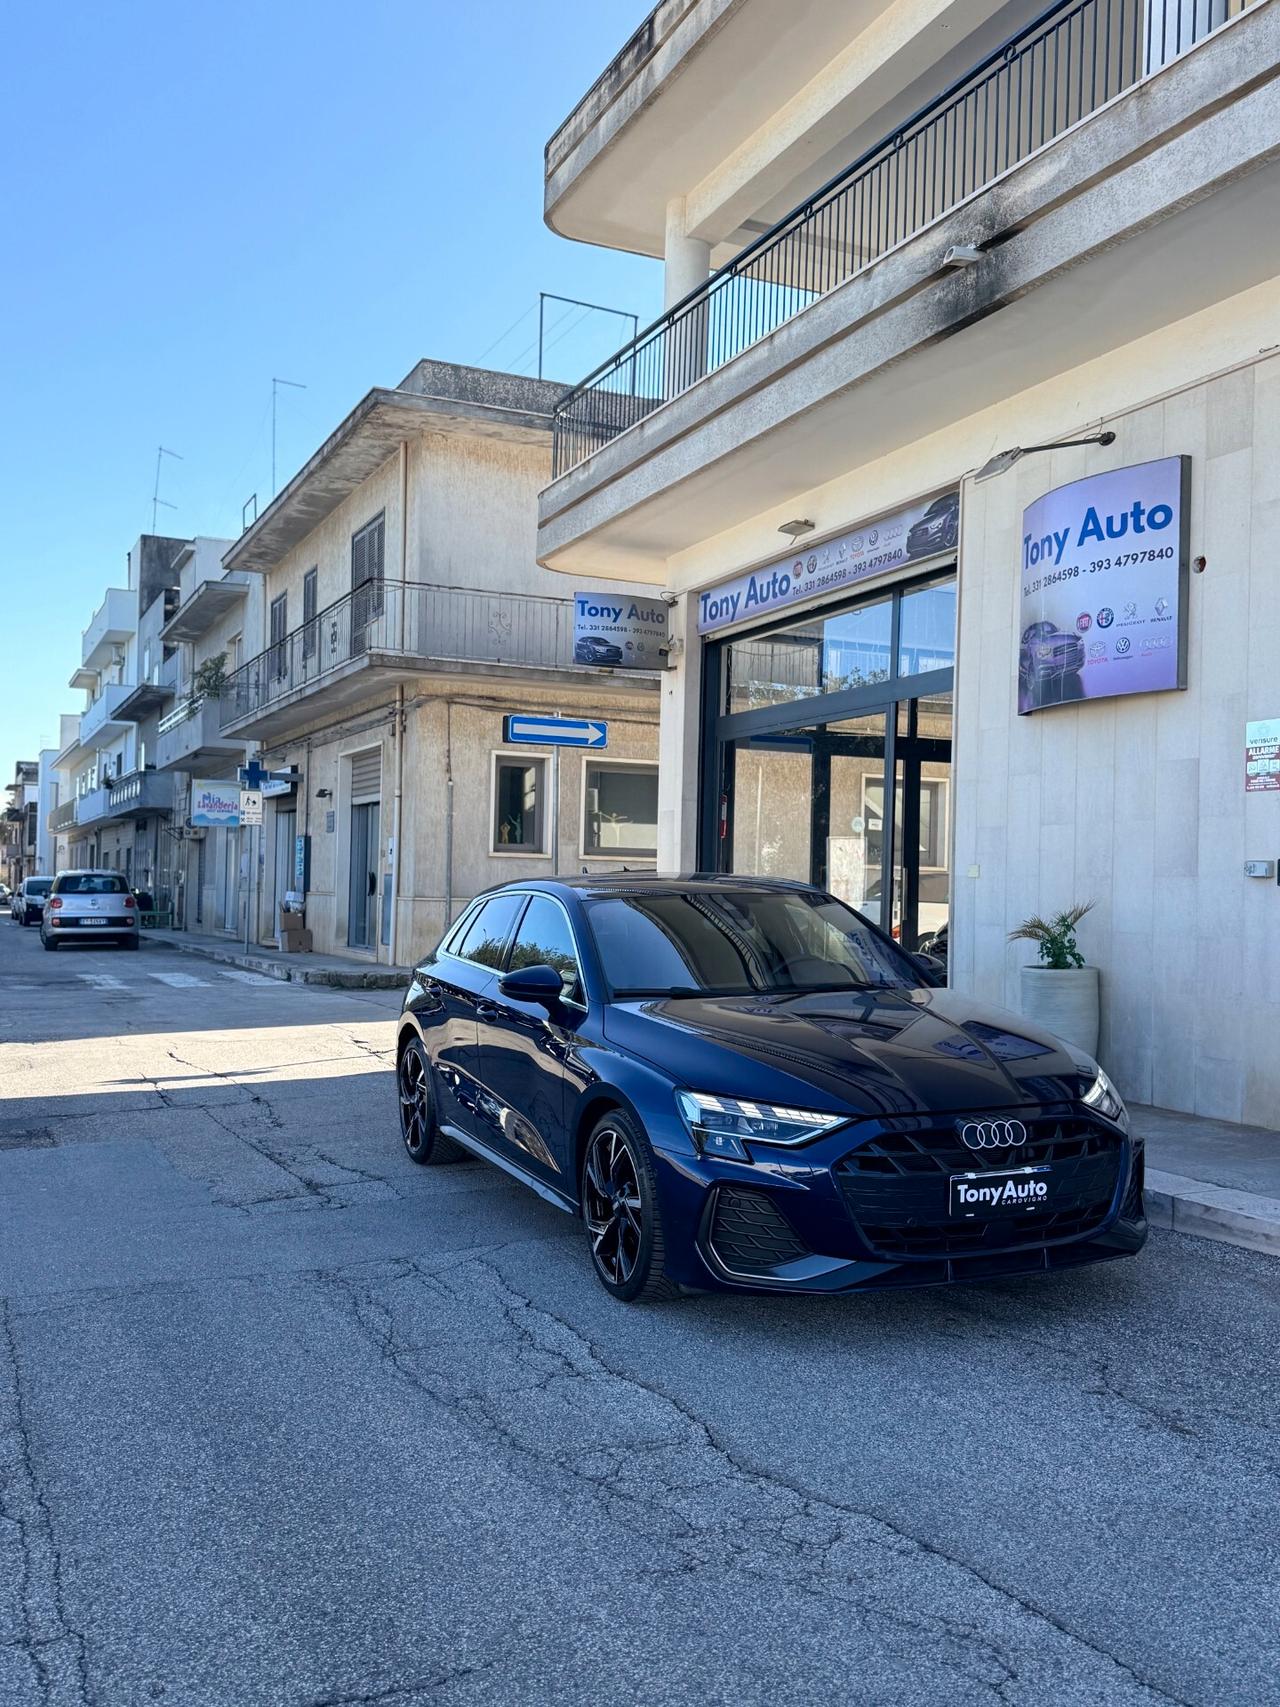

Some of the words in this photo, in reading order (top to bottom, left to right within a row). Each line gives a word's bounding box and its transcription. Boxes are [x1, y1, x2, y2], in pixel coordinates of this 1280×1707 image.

[1024, 527, 1071, 570] Tony
[1077, 500, 1173, 547] Auto
[792, 585, 803, 596] Tel.
[804, 580, 815, 592] 331
[816, 568, 847, 588] 2864598
[853, 562, 867, 575] 393
[867, 548, 903, 569] 4797840
[1032, 580, 1042, 594] 331
[1043, 566, 1080, 588] 2864598
[1089, 558, 1111, 573] 393
[1114, 546, 1174, 568] 4797840
[577, 600, 623, 623] Tony
[627, 604, 665, 624] Auto
[701, 591, 742, 624] Tony
[744, 570, 791, 608] Auto
[1248, 745, 1280, 756] ALLARME
[957, 1180, 1048, 1206] TonyAuto
[1001, 1195, 1048, 1206] CAROVIGNO
